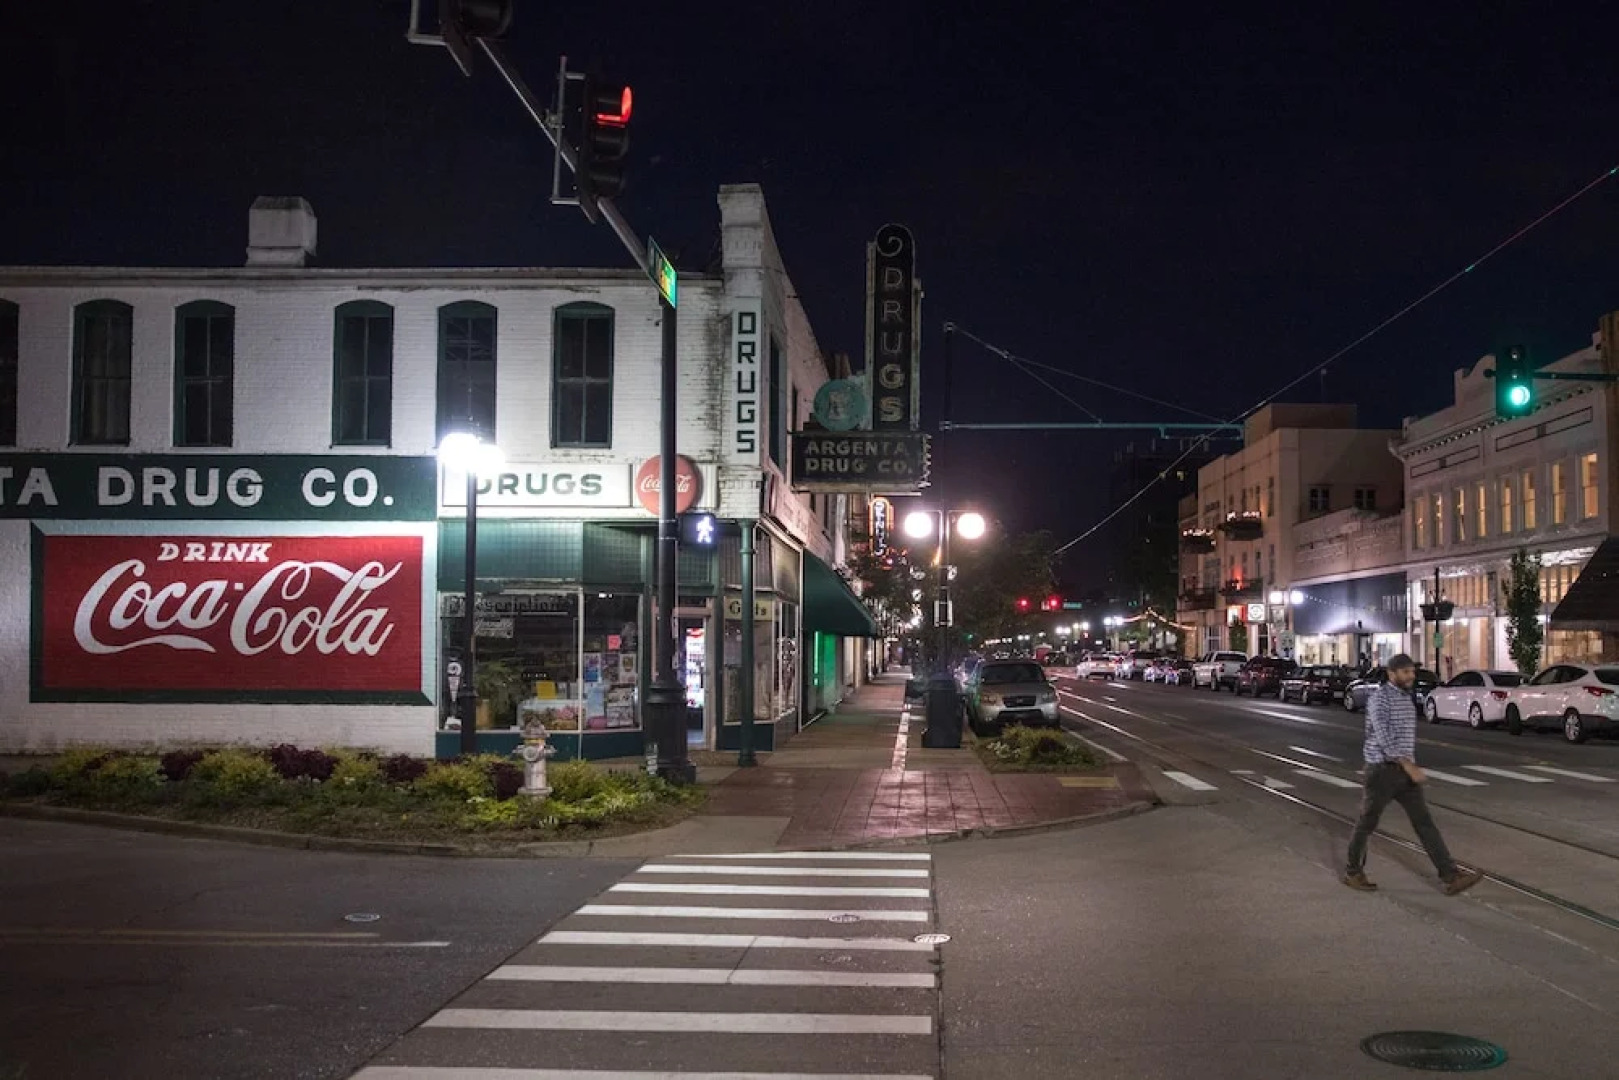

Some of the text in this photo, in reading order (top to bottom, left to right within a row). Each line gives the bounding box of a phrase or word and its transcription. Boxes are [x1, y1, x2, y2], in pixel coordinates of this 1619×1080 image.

[878, 266, 906, 422] DRUGS
[737, 311, 756, 454] DRUGS
[805, 458, 914, 474] DRUG CO.
[806, 441, 909, 456] ARGENTA
[97, 466, 264, 507] DRUG
[302, 467, 395, 507] CO.
[157, 541, 273, 563] DRINK
[73, 558, 403, 656] Coca-Cola
